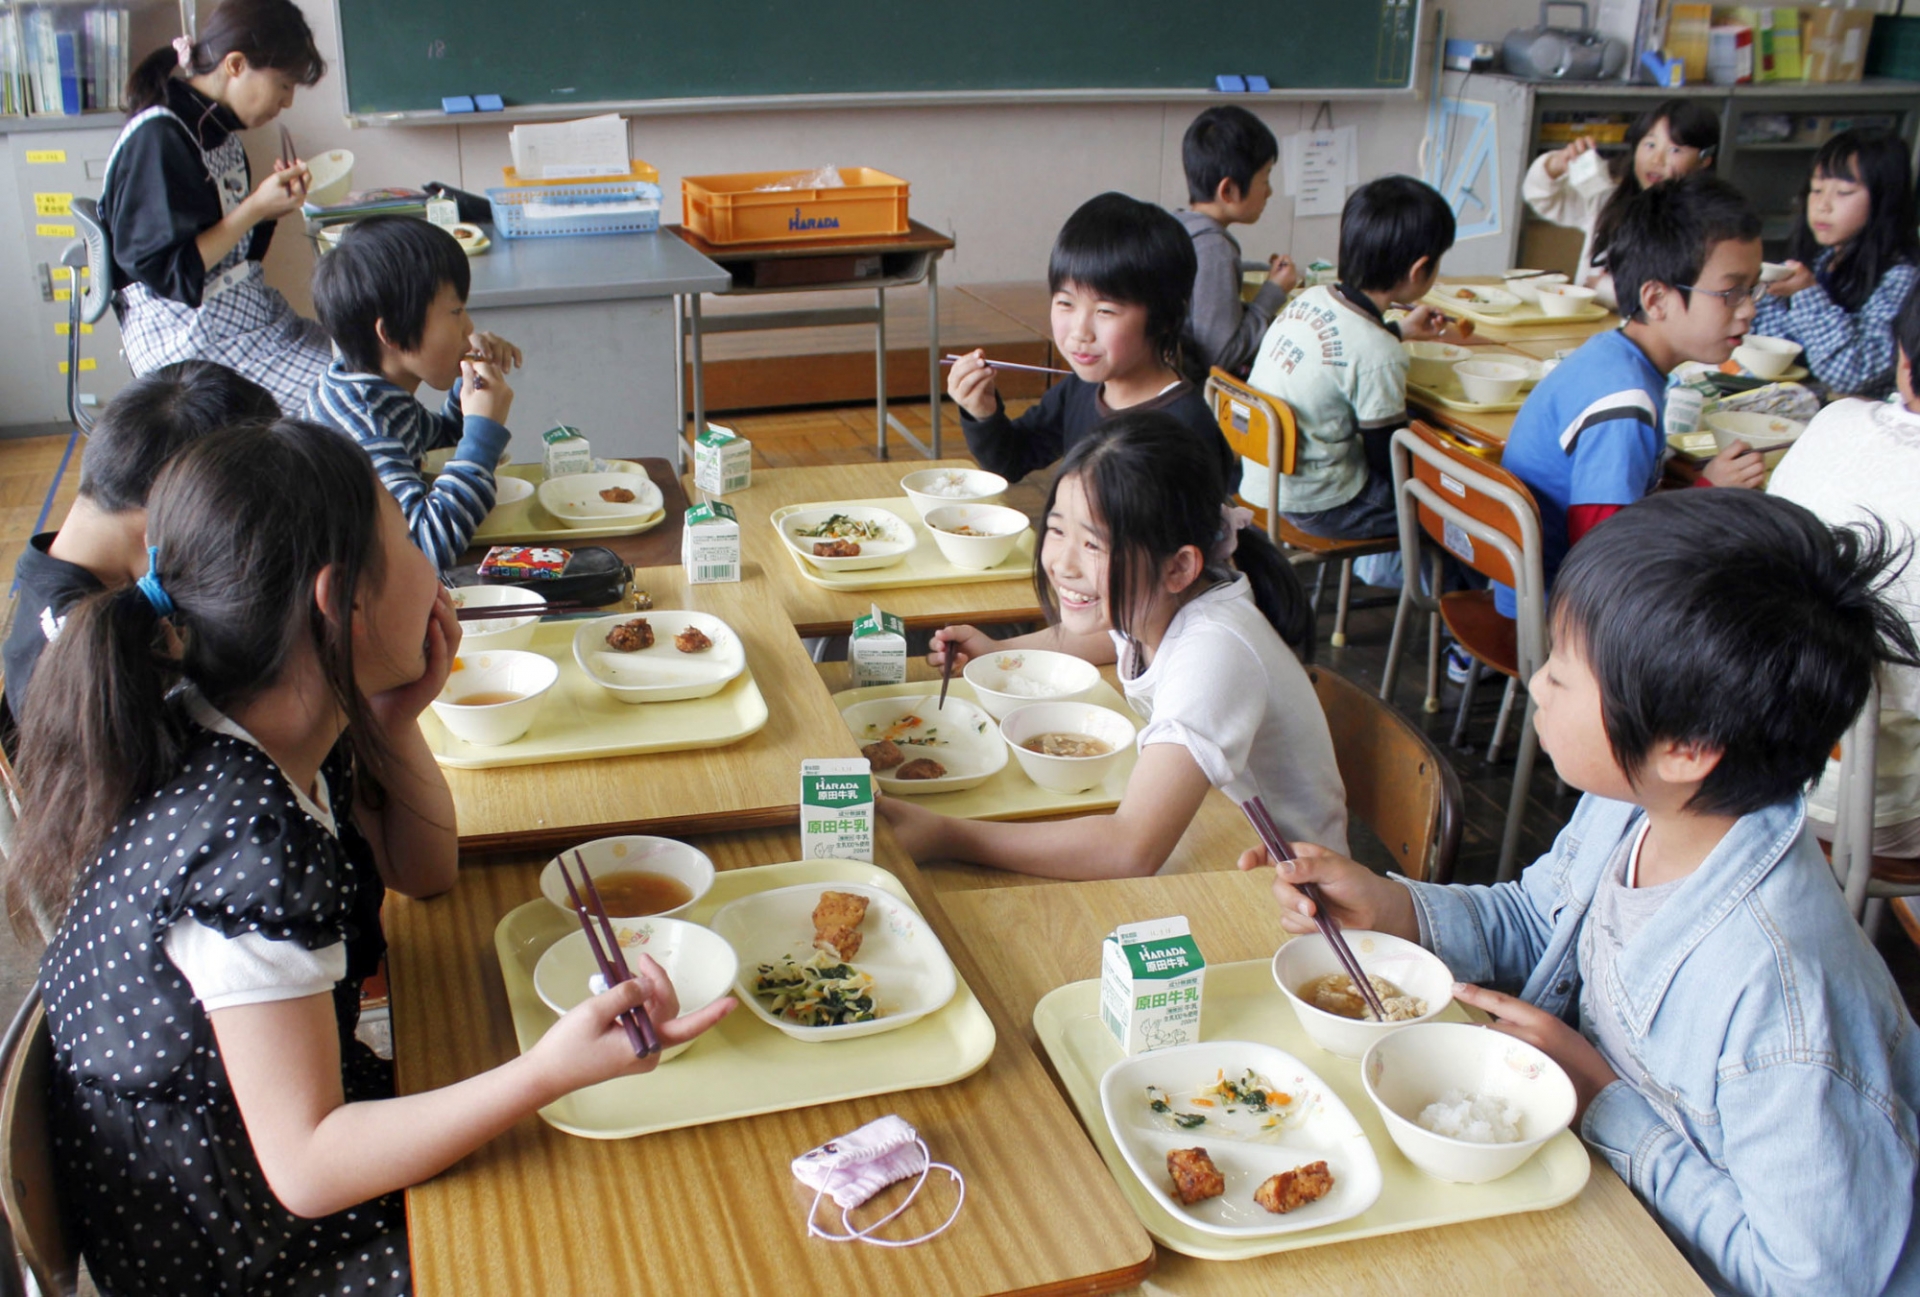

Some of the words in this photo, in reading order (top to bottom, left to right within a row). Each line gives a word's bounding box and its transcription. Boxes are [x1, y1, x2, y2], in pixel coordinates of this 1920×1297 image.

[788, 208, 840, 231] HARADA
[815, 777, 859, 790] HARADA
[817, 790, 858, 800] 原田牛乳
[807, 819, 869, 834] 原田牛乳
[1139, 945, 1187, 961] HARADA
[1145, 956, 1189, 973] 原田牛乳
[1135, 986, 1199, 1011] 原田牛乳
